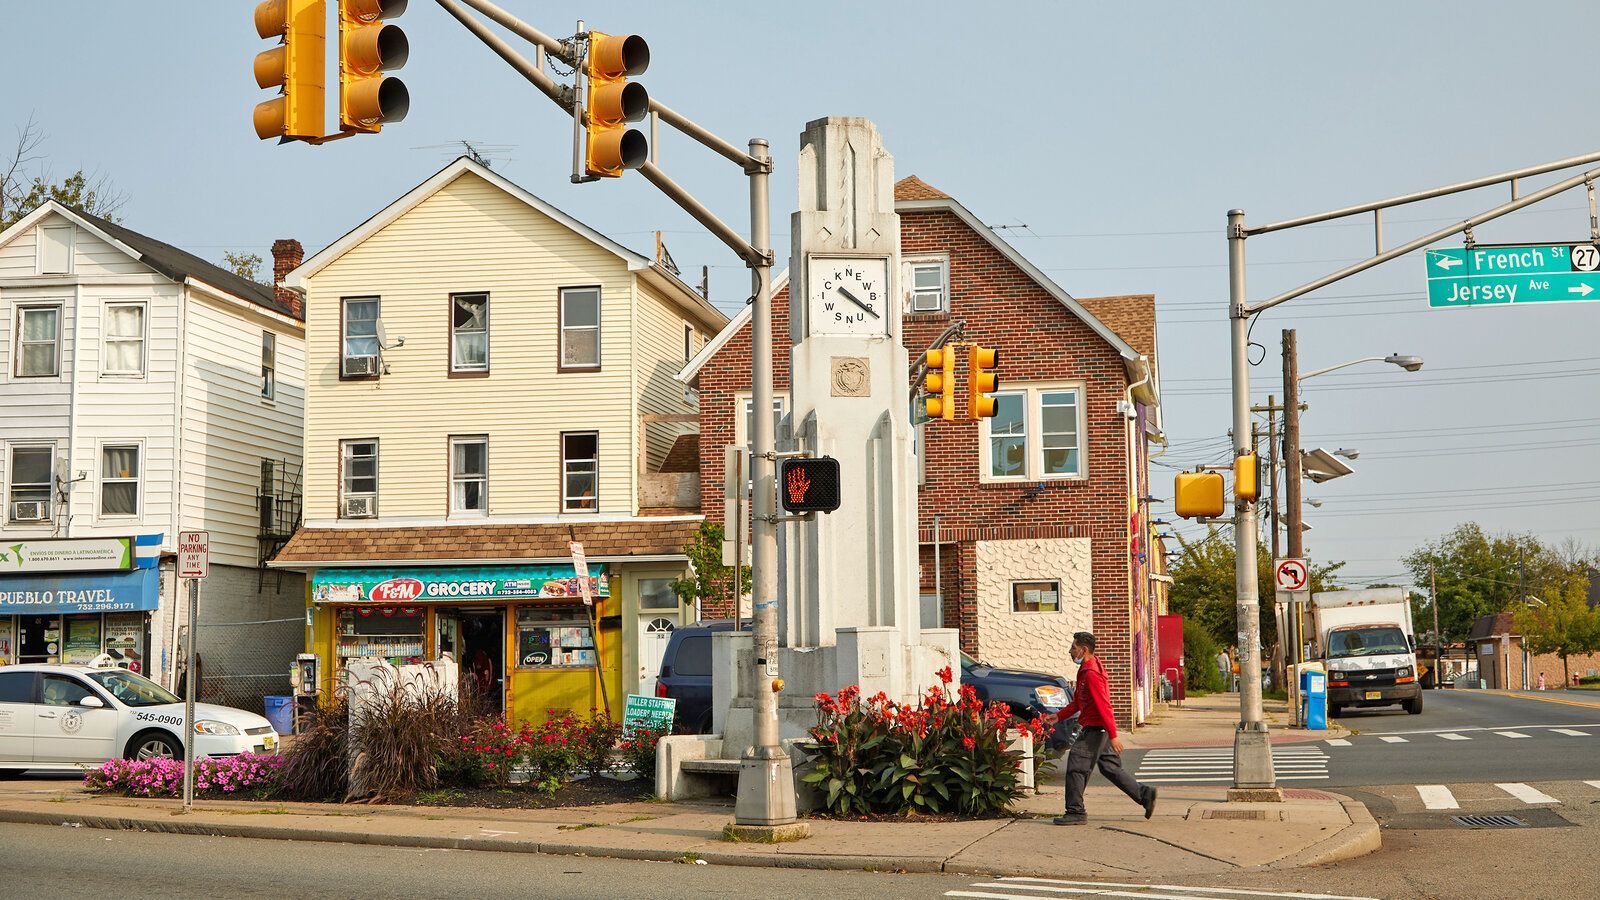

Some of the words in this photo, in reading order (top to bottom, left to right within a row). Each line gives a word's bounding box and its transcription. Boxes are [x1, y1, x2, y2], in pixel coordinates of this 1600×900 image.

[1474, 248, 1545, 270] French
[1551, 246, 1564, 258] St
[1575, 249, 1596, 267] 27
[1447, 283, 1518, 304] Jersey
[1529, 279, 1550, 290] Ave
[188, 533, 200, 542] NO
[180, 543, 207, 553] PARKING
[0, 590, 54, 604] PUEBLO
[57, 589, 115, 604] TRAVEL
[379, 583, 416, 599] F&M
[426, 581, 497, 597] GROCERY
[77, 602, 135, 610] 732.296.9171
[648, 699, 674, 710] STAFFING
[136, 712, 183, 726] 545-0900
